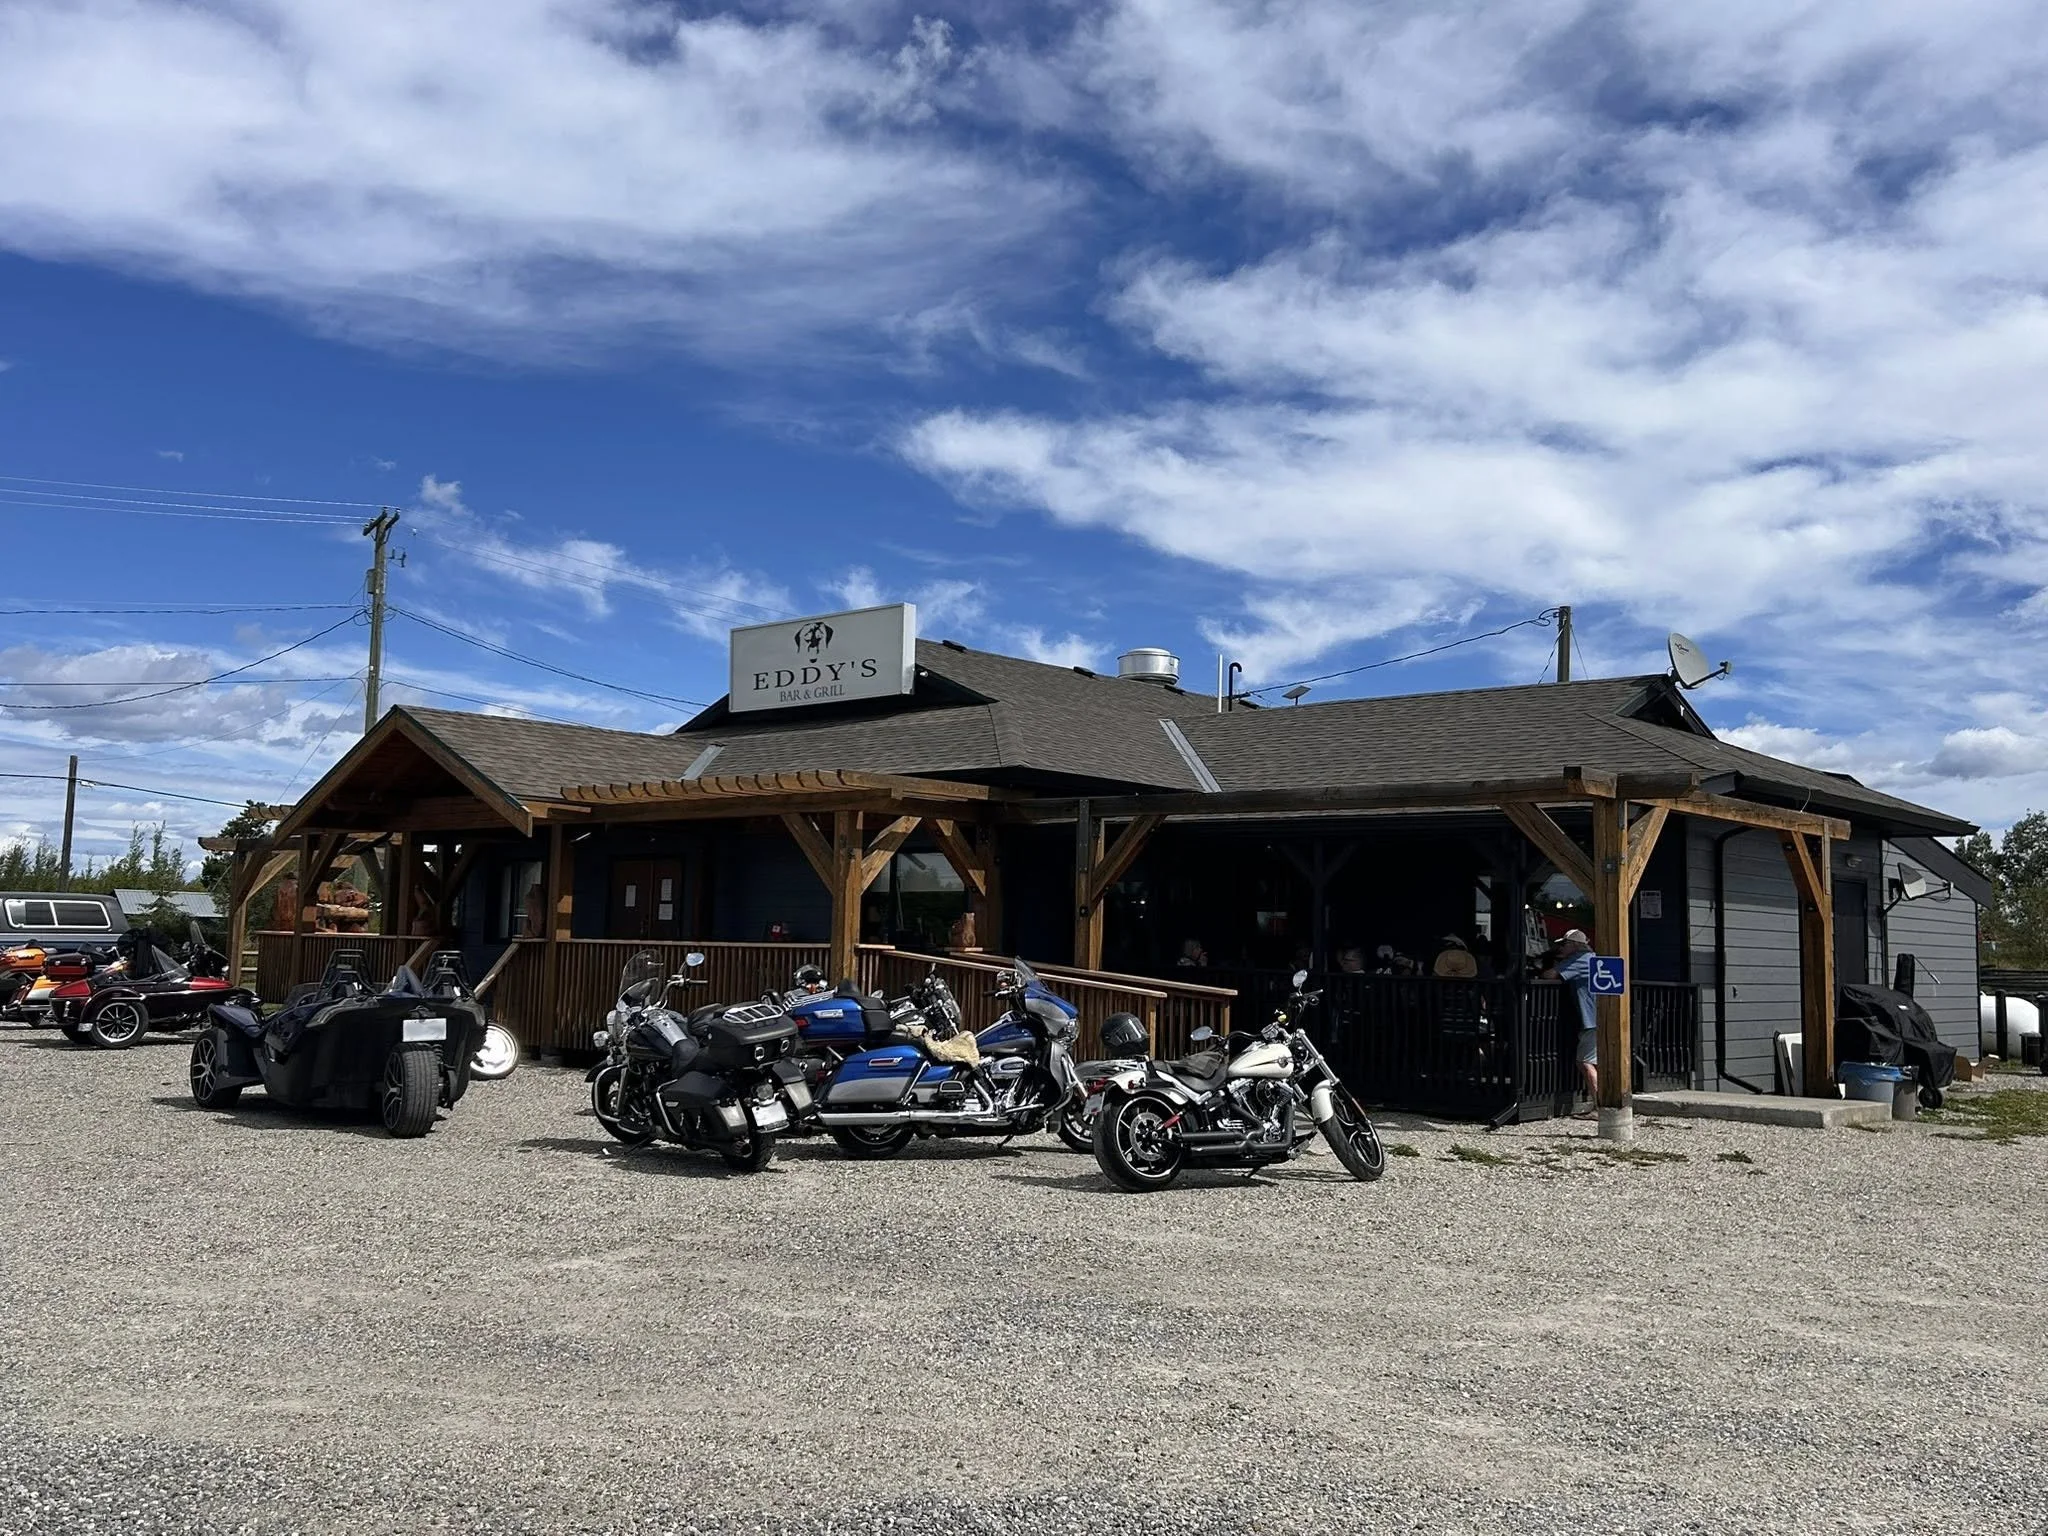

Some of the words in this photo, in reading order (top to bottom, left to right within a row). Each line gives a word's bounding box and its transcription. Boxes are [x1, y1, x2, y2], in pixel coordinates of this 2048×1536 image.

[753, 658, 877, 691] EDDY'S
[780, 689, 802, 702] BAR
[804, 688, 812, 700] &
[814, 685, 845, 699] GRILL
